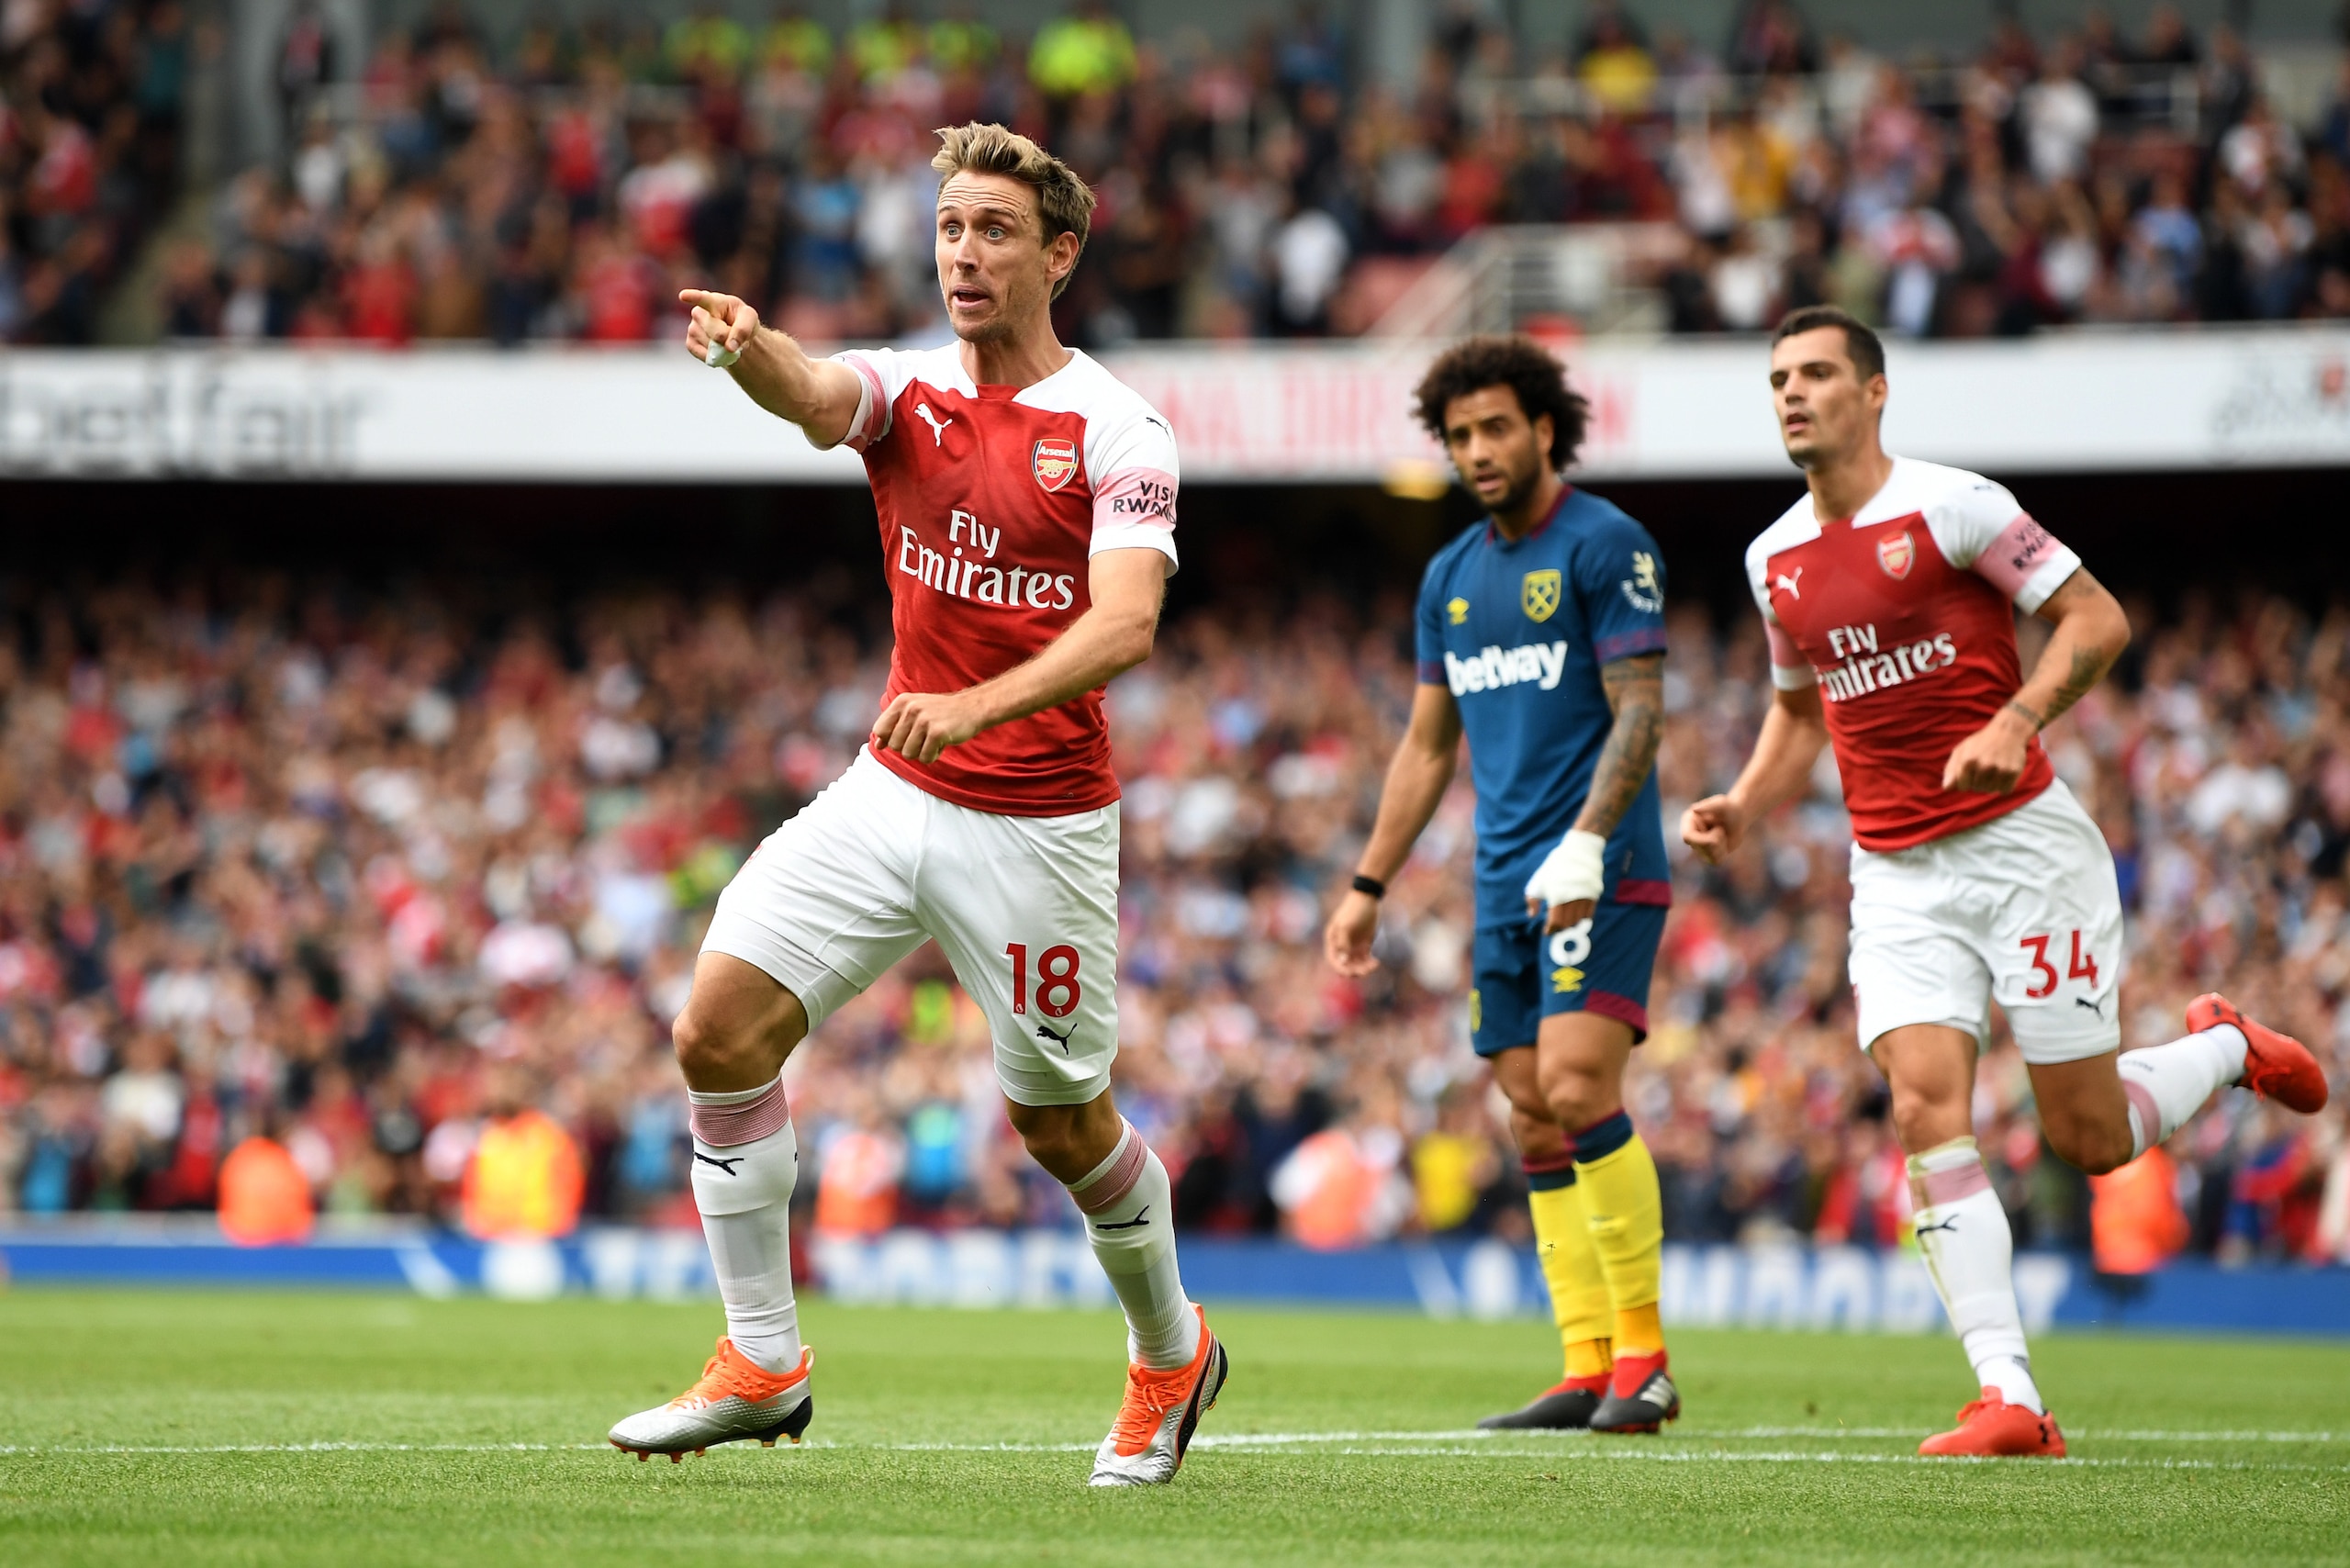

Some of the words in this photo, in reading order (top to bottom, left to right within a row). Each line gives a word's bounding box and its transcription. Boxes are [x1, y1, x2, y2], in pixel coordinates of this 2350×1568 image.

[1039, 445, 1073, 457] Arsenal
[948, 509, 1001, 559] Fly
[899, 524, 1075, 610] Emirates
[1443, 640, 1568, 698] betway
[1827, 622, 1879, 659] Fly
[1005, 942, 1081, 1018] 18
[2020, 929, 2098, 999] 34
